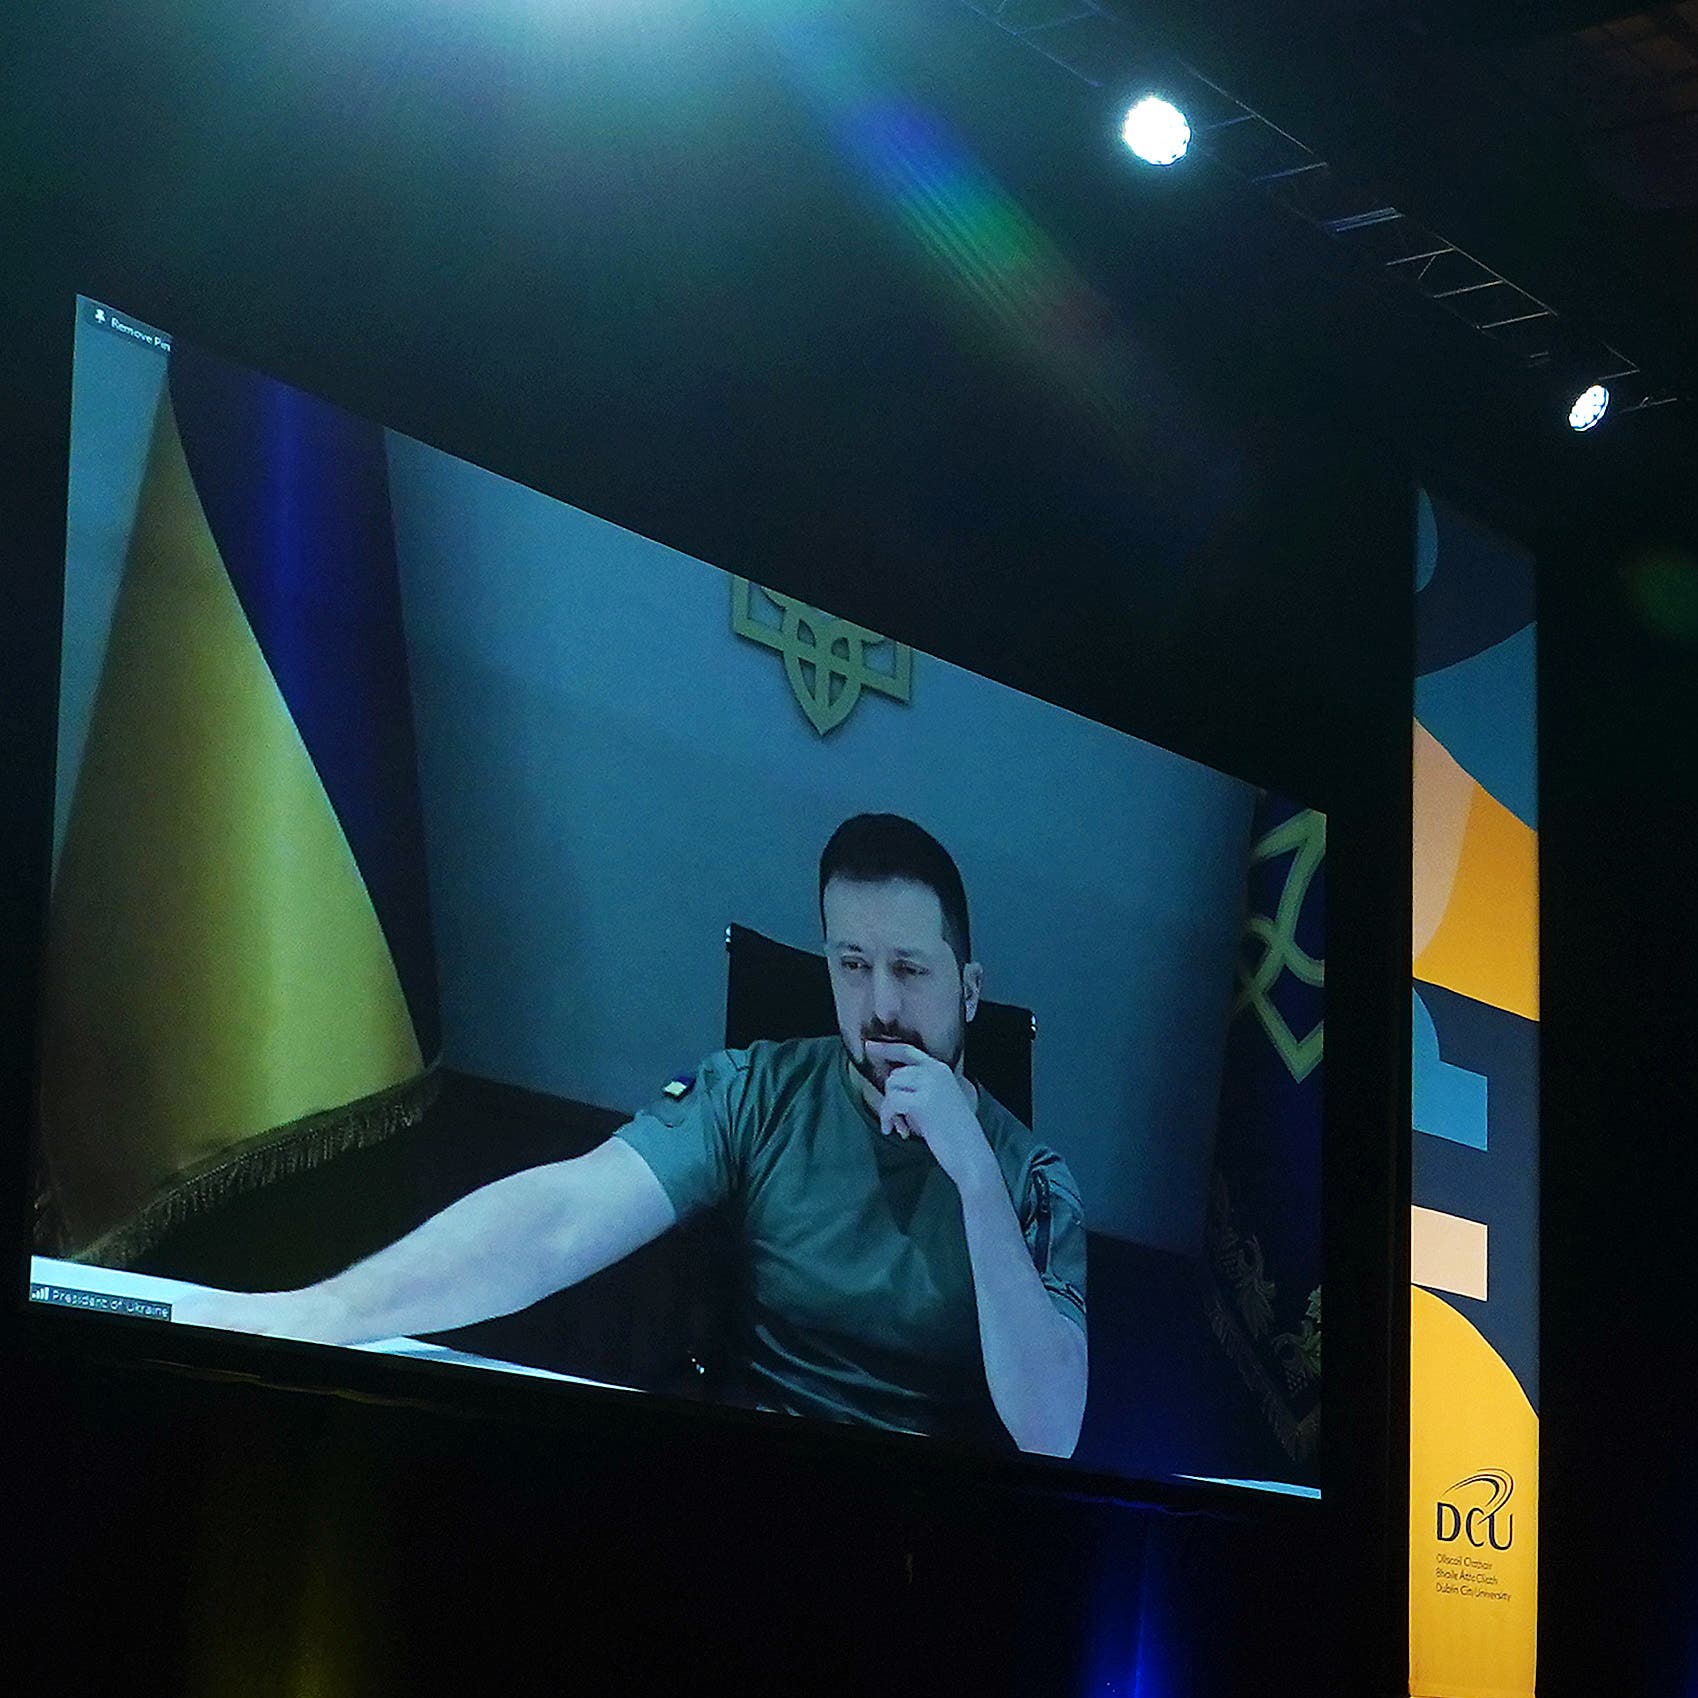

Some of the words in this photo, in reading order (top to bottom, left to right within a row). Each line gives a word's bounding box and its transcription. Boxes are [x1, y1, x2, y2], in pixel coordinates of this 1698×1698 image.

[52, 1289, 109, 1309] President
[126, 1301, 169, 1318] Ukraine
[1436, 1501, 1513, 1551] DCU
